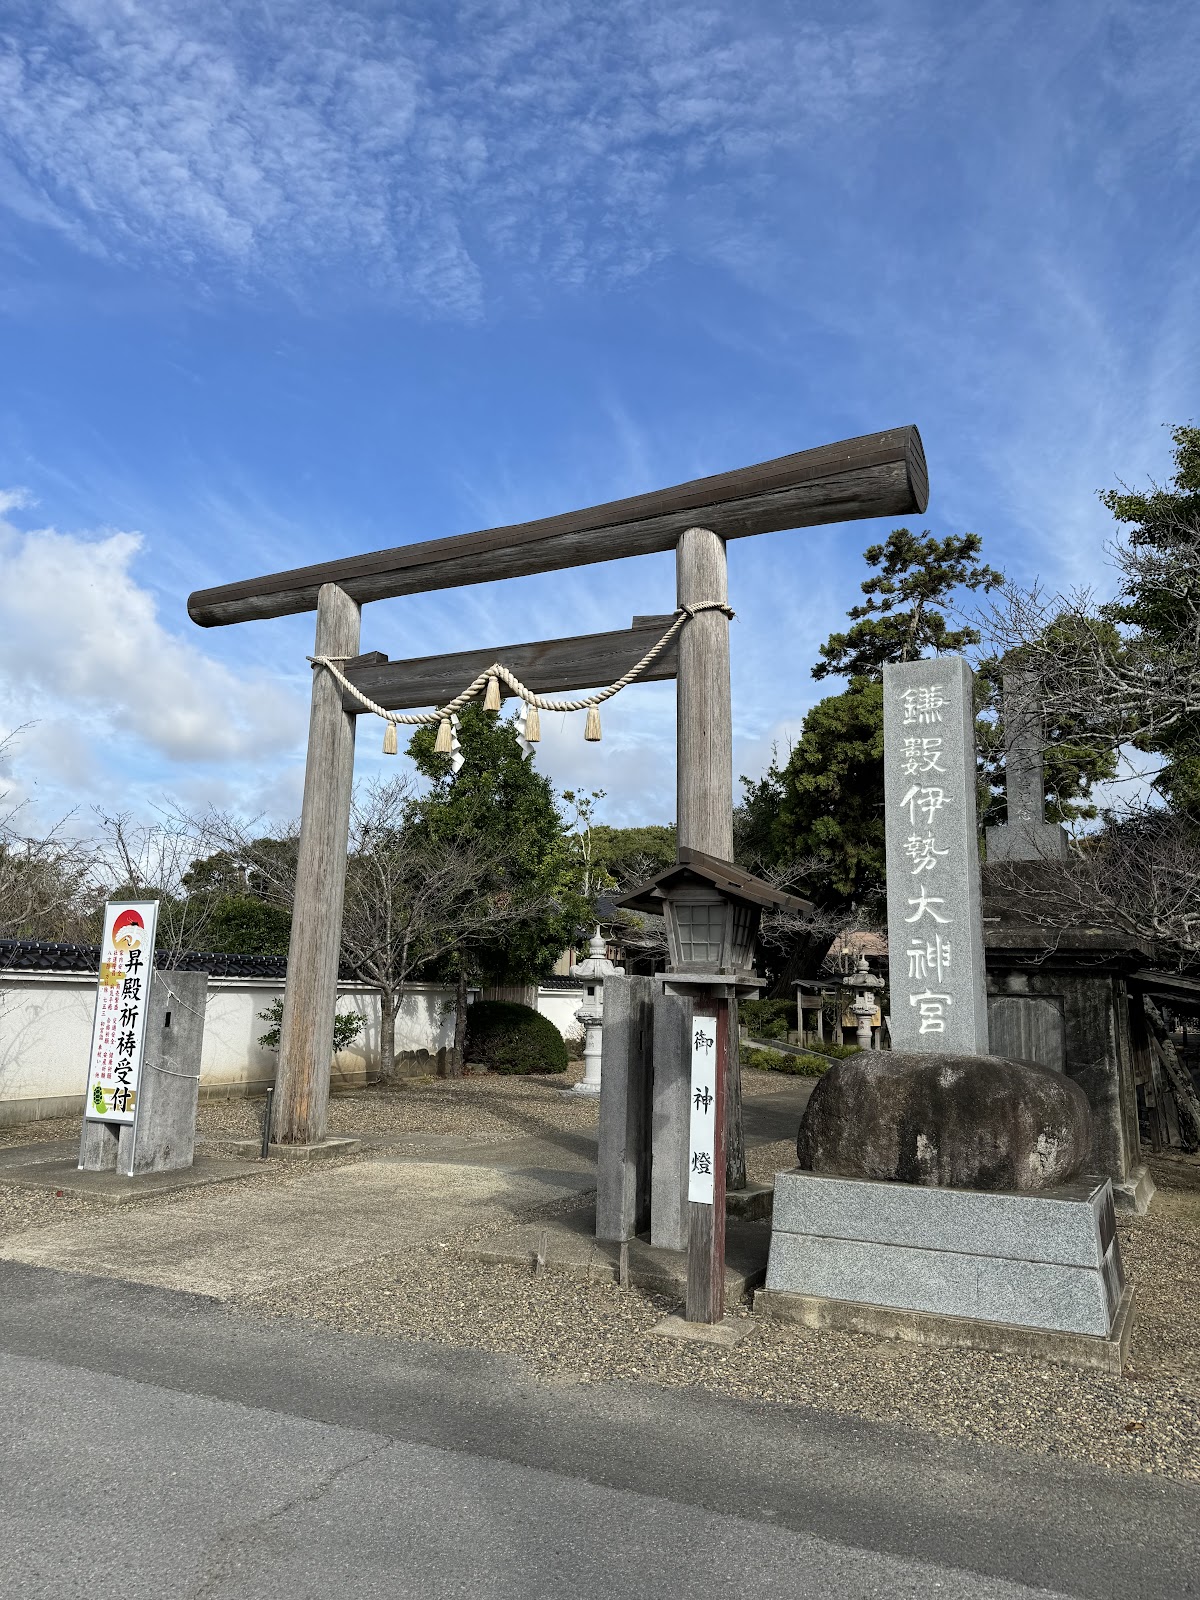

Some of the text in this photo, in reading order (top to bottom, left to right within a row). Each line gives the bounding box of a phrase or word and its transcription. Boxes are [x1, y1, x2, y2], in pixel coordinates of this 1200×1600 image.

[111, 949, 143, 1113] 昇殿祈祷受付
[691, 1029, 714, 1175] 御神燈
